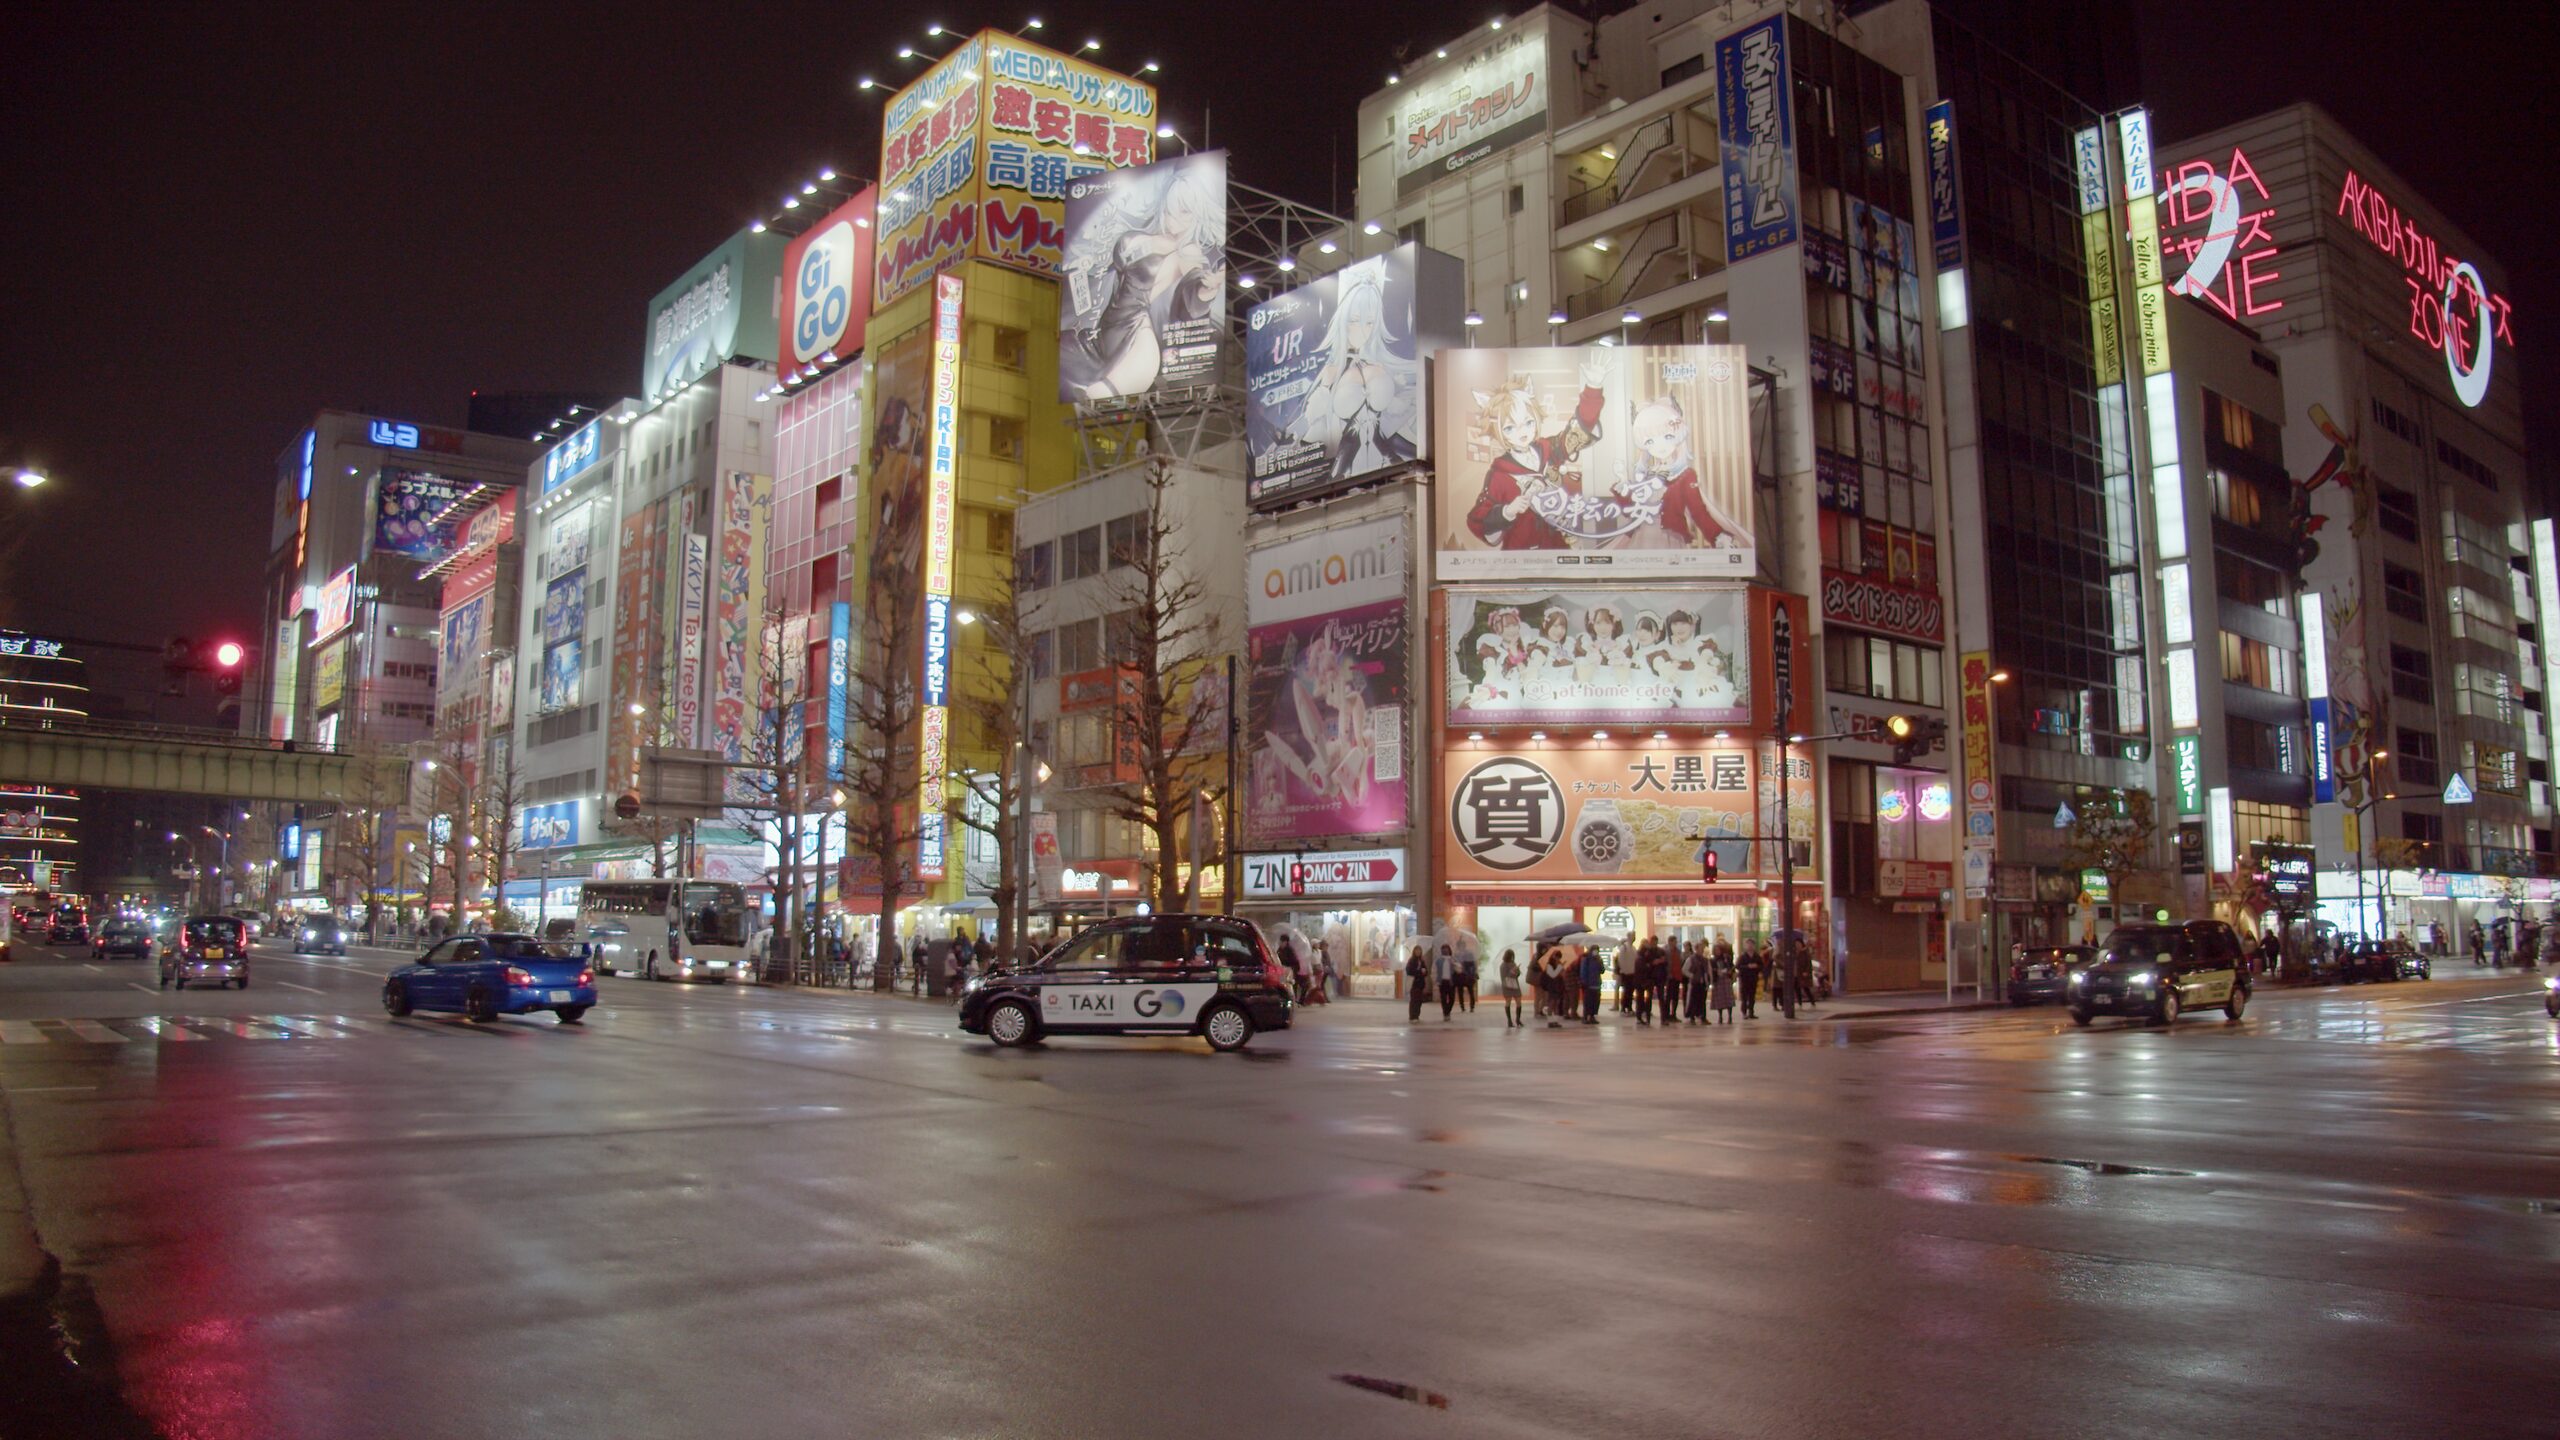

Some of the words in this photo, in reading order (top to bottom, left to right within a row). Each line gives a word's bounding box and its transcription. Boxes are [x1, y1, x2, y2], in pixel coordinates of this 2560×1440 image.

[992, 46, 1152, 115] MEDIAリサイクル
[992, 84, 1151, 166] 激安販売
[1407, 72, 1534, 160] メイドカジノ
[2127, 120, 2146, 191] スーパービル
[1001, 247, 1051, 269] ムーラン
[1826, 261, 1847, 288] 7F
[2136, 236, 2151, 281] Yellow
[1272, 325, 1304, 366] UR
[2142, 293, 2159, 366] Submarine
[2406, 278, 2471, 374] ZONE
[1832, 369, 1853, 395] 6F
[1531, 479, 1662, 528] 回転の宴
[1839, 482, 1859, 510] 5F
[688, 538, 703, 599] AKKY
[1264, 543, 1386, 598] amiami
[1826, 578, 1940, 635] メイドカジノ
[682, 615, 700, 696] Tax-free
[1339, 627, 1400, 657] アイリン
[1628, 753, 1748, 794] 大黒屋
[2315, 721, 2328, 781] GALLERIA
[1572, 780, 1622, 793] チケット
[1466, 774, 1549, 856] 質
[1249, 857, 1286, 892] ZIN
[1303, 862, 1343, 882] OMIC
[1345, 861, 1370, 881] ZIN
[1068, 994, 1114, 1011] TAXI
